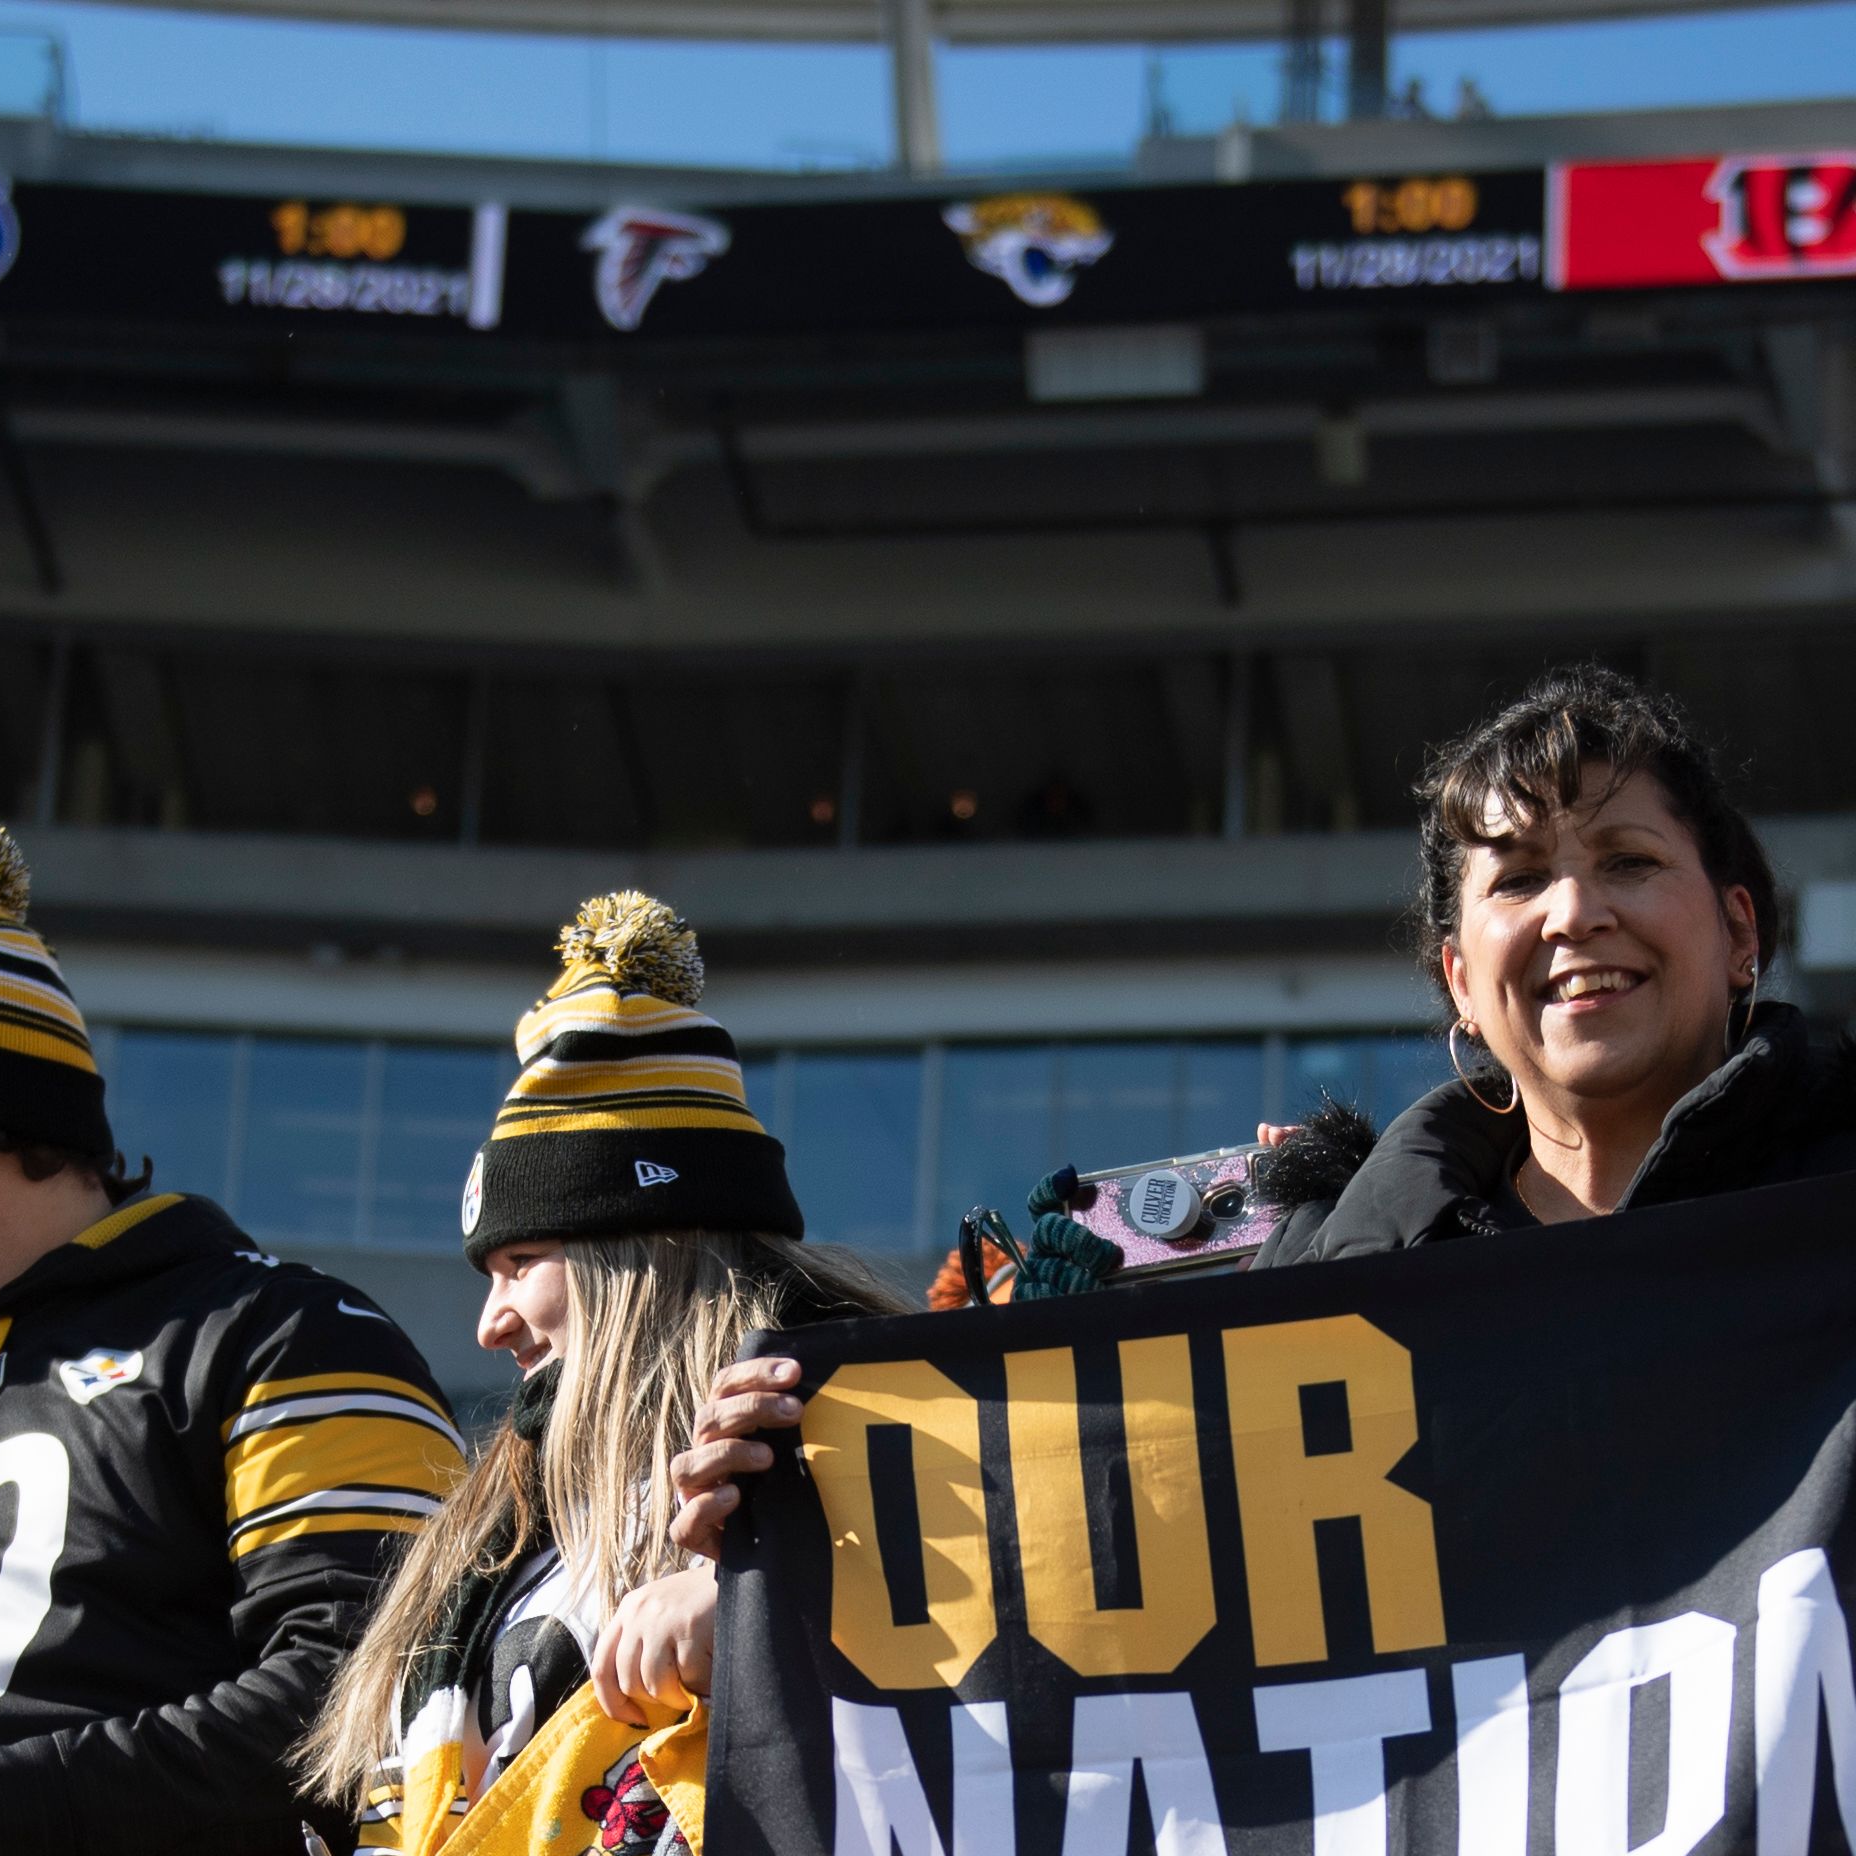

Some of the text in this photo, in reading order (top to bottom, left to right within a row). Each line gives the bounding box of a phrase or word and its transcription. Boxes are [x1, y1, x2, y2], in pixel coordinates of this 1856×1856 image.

[270, 200, 406, 260] 1:00
[1342, 177, 1478, 234] 1:00
[218, 262, 471, 316] 11/28/2021
[1290, 236, 1540, 289] 11/28/2021
[1140, 1178, 1165, 1224] CULVER
[802, 1312, 1447, 1691] OUR
